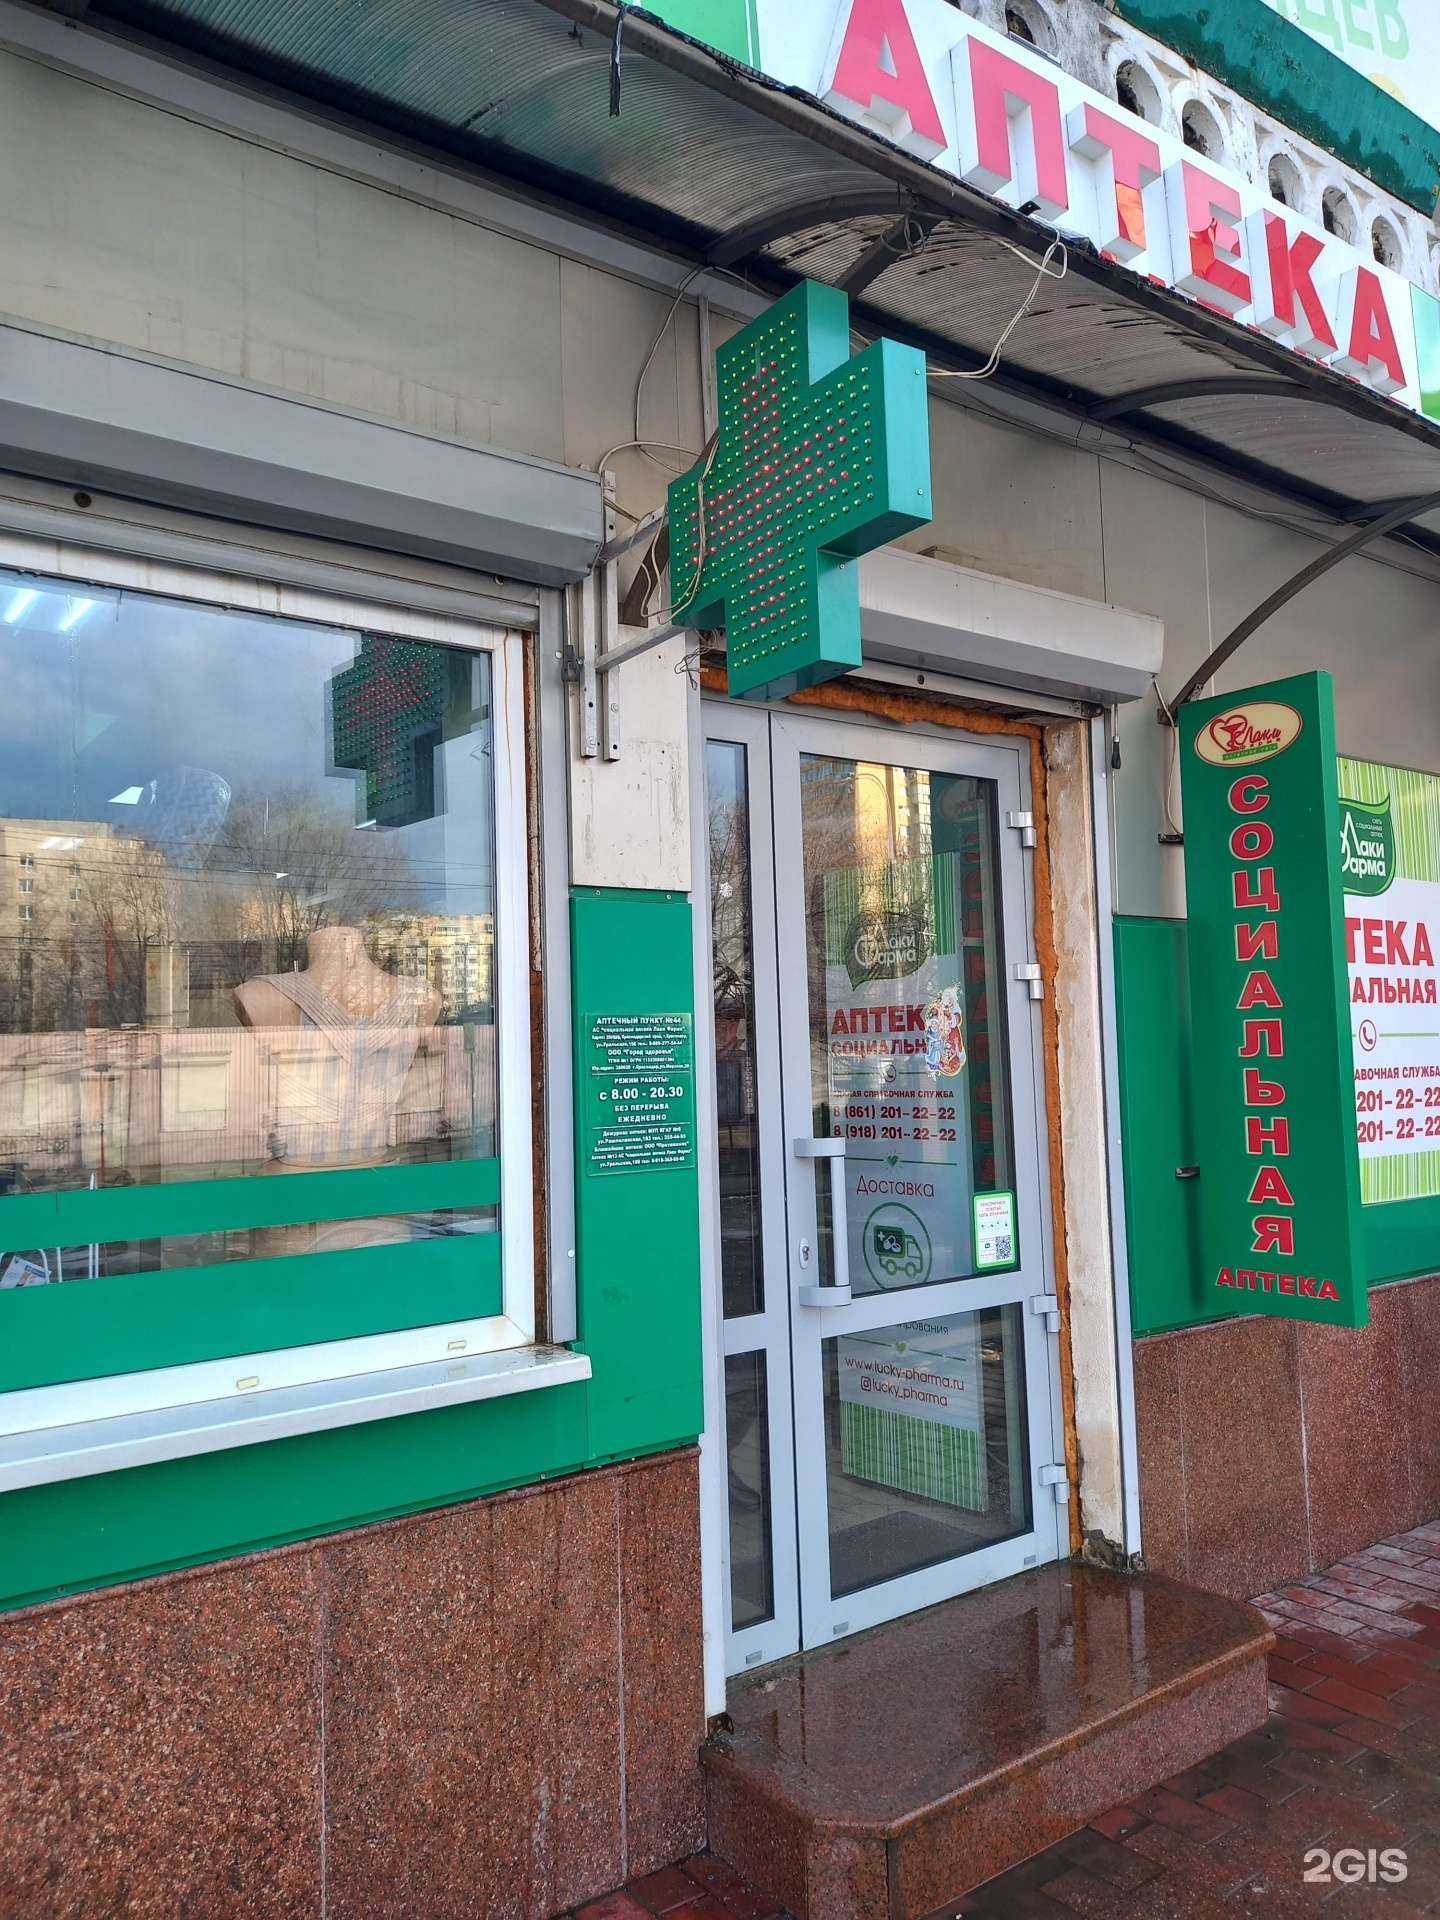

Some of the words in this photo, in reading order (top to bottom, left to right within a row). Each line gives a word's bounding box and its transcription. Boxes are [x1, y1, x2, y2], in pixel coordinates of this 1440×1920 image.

[820, 0, 1407, 392] АПТЕКА
[1341, 811, 1384, 858] Лаки
[1350, 976, 1437, 1004] АЛЬНАЯ
[596, 1016, 638, 1025] АПТЕЧНЫЙ
[1227, 774, 1295, 1256] СОЦИАЛЬНАЯ
[1402, 1065, 1440, 1078] СЛУЖБА
[611, 1088, 638, 1100] 8.00
[650, 1086, 684, 1098] 20.30
[917, 1089, 954, 1098] СЛУЖБА
[630, 1103, 669, 1111] ПЕРЕРЫВА
[833, 1106, 841, 1116] 8
[845, 1104, 876, 1119] (861)
[618, 1114, 667, 1123] ЕЖЕДНЕВНО
[833, 1125, 841, 1137] 8
[845, 1124, 877, 1140] (918)
[856, 1175, 935, 1198] Доставка
[1215, 1266, 1341, 1301] АПТЕКА
[844, 1357, 965, 1390] www.lucky-pharma.ru
